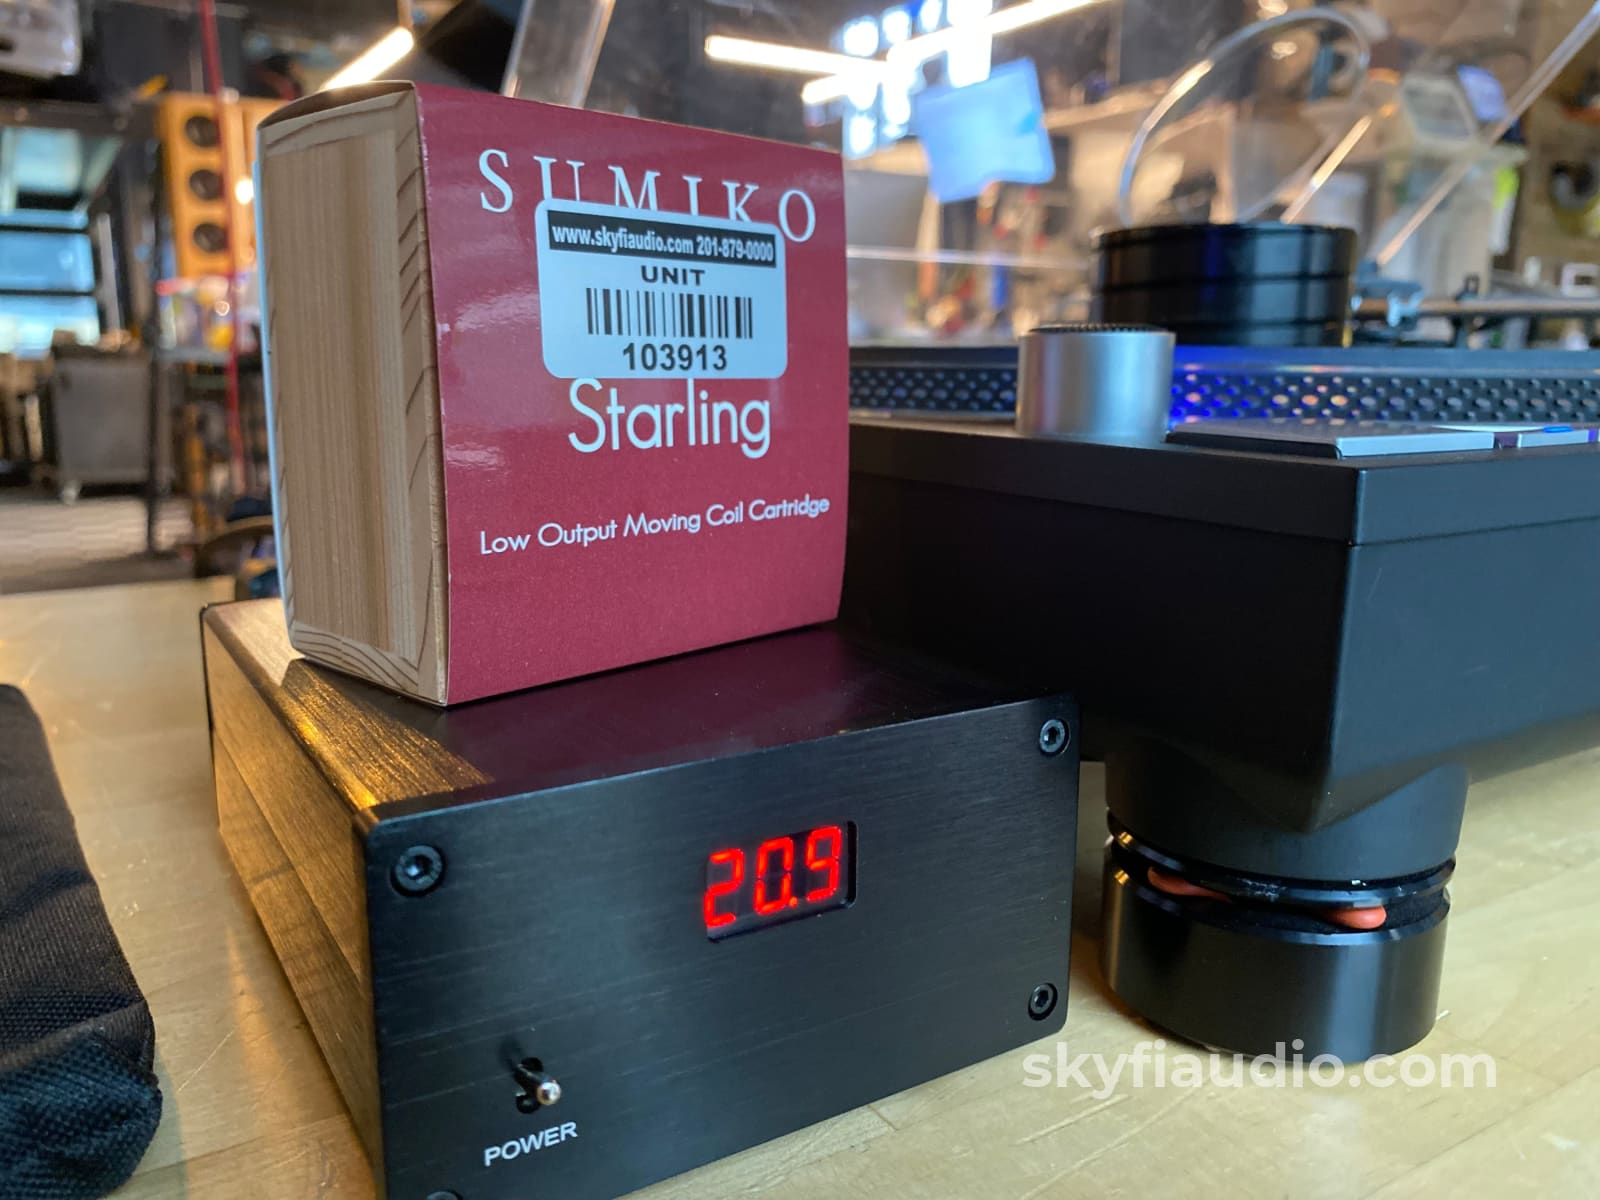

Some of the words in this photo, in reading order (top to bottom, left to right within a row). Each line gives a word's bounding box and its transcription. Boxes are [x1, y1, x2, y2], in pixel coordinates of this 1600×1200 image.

[478, 149, 816, 242] SUMIKO
[551, 224, 694, 255] www.skyfiaudio.com
[697, 234, 774, 263] 201-879-0000
[640, 264, 706, 286] UNIT
[622, 342, 727, 371] 103913
[568, 377, 771, 459] Starling
[480, 530, 531, 555] Low
[537, 519, 618, 547] Output
[623, 512, 701, 537] Moving
[706, 500, 744, 526] Coil
[748, 493, 830, 521] Cartridge
[703, 825, 842, 927] 20.9
[483, 1121, 578, 1167] POWER
